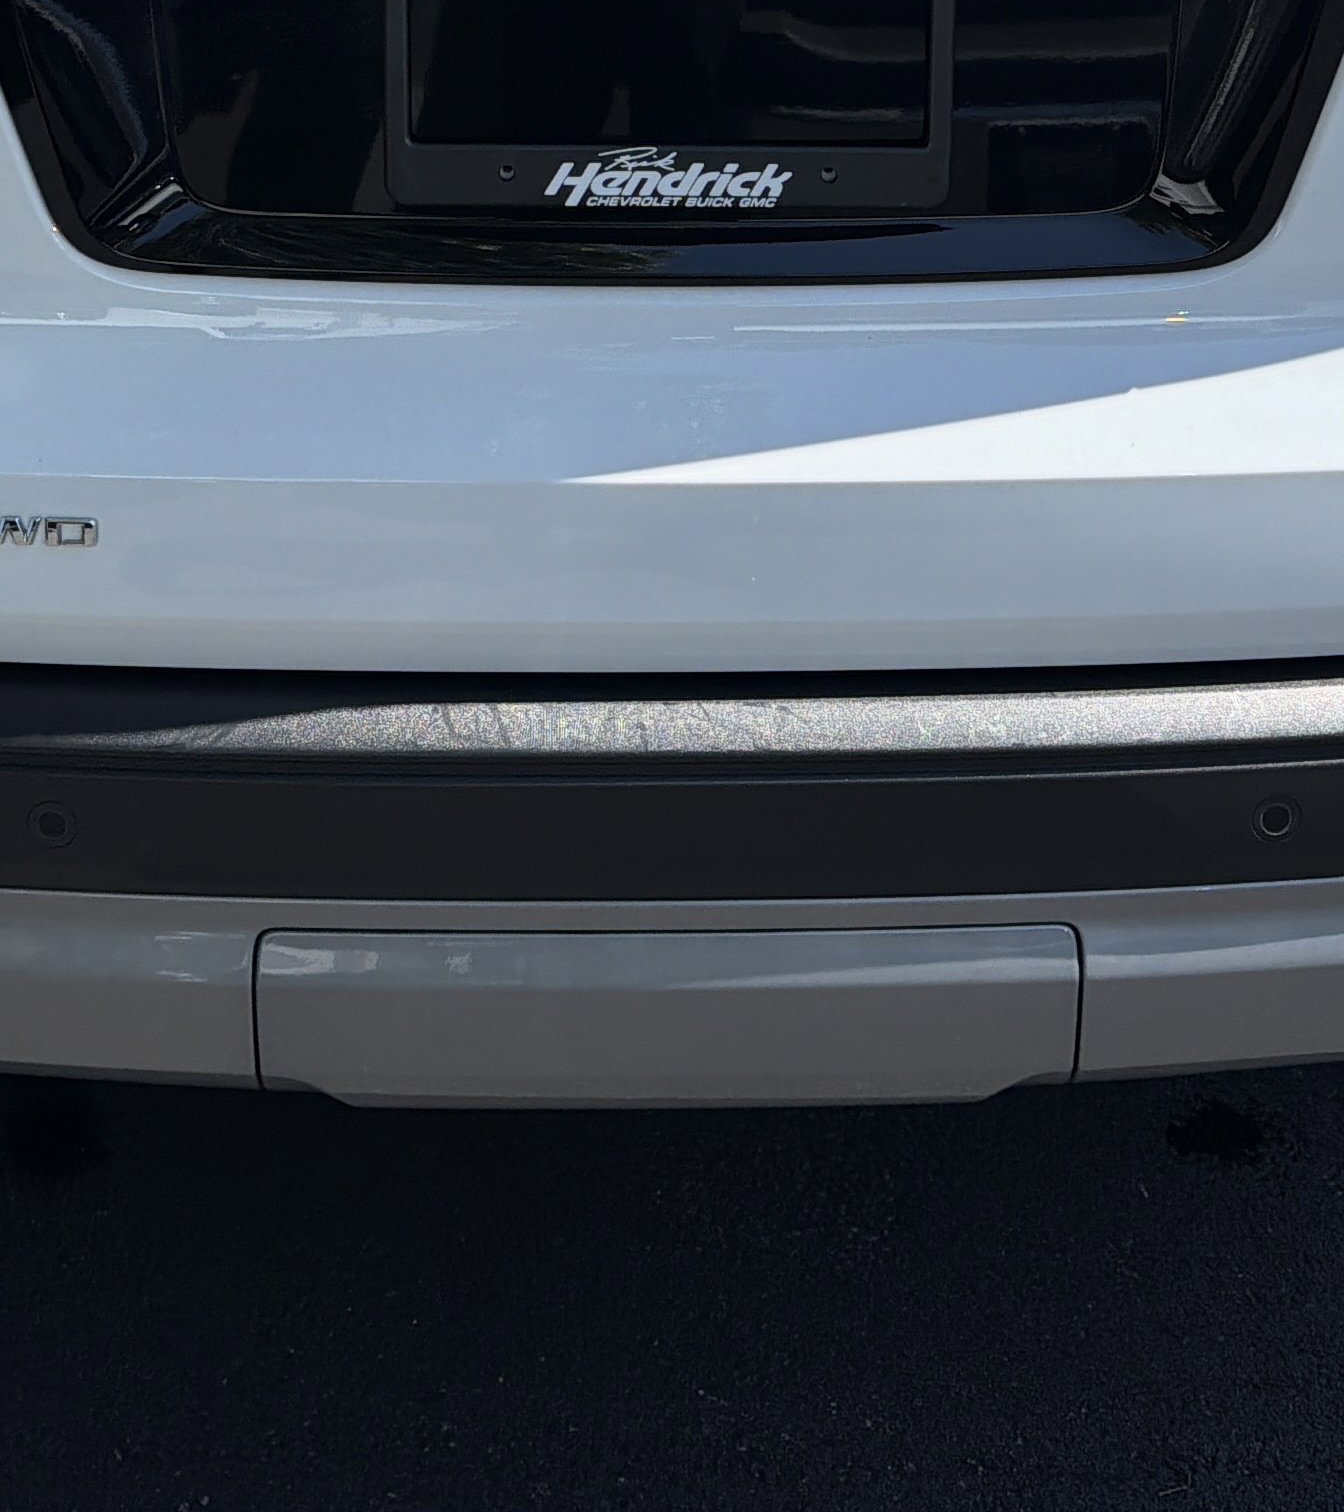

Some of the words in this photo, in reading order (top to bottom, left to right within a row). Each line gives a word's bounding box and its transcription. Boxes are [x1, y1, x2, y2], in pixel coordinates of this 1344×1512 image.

[544, 162, 793, 207] Hendrick
[585, 195, 682, 208] CHEVROLET
[684, 196, 736, 208] BUICK
[737, 197, 778, 209] GMC
